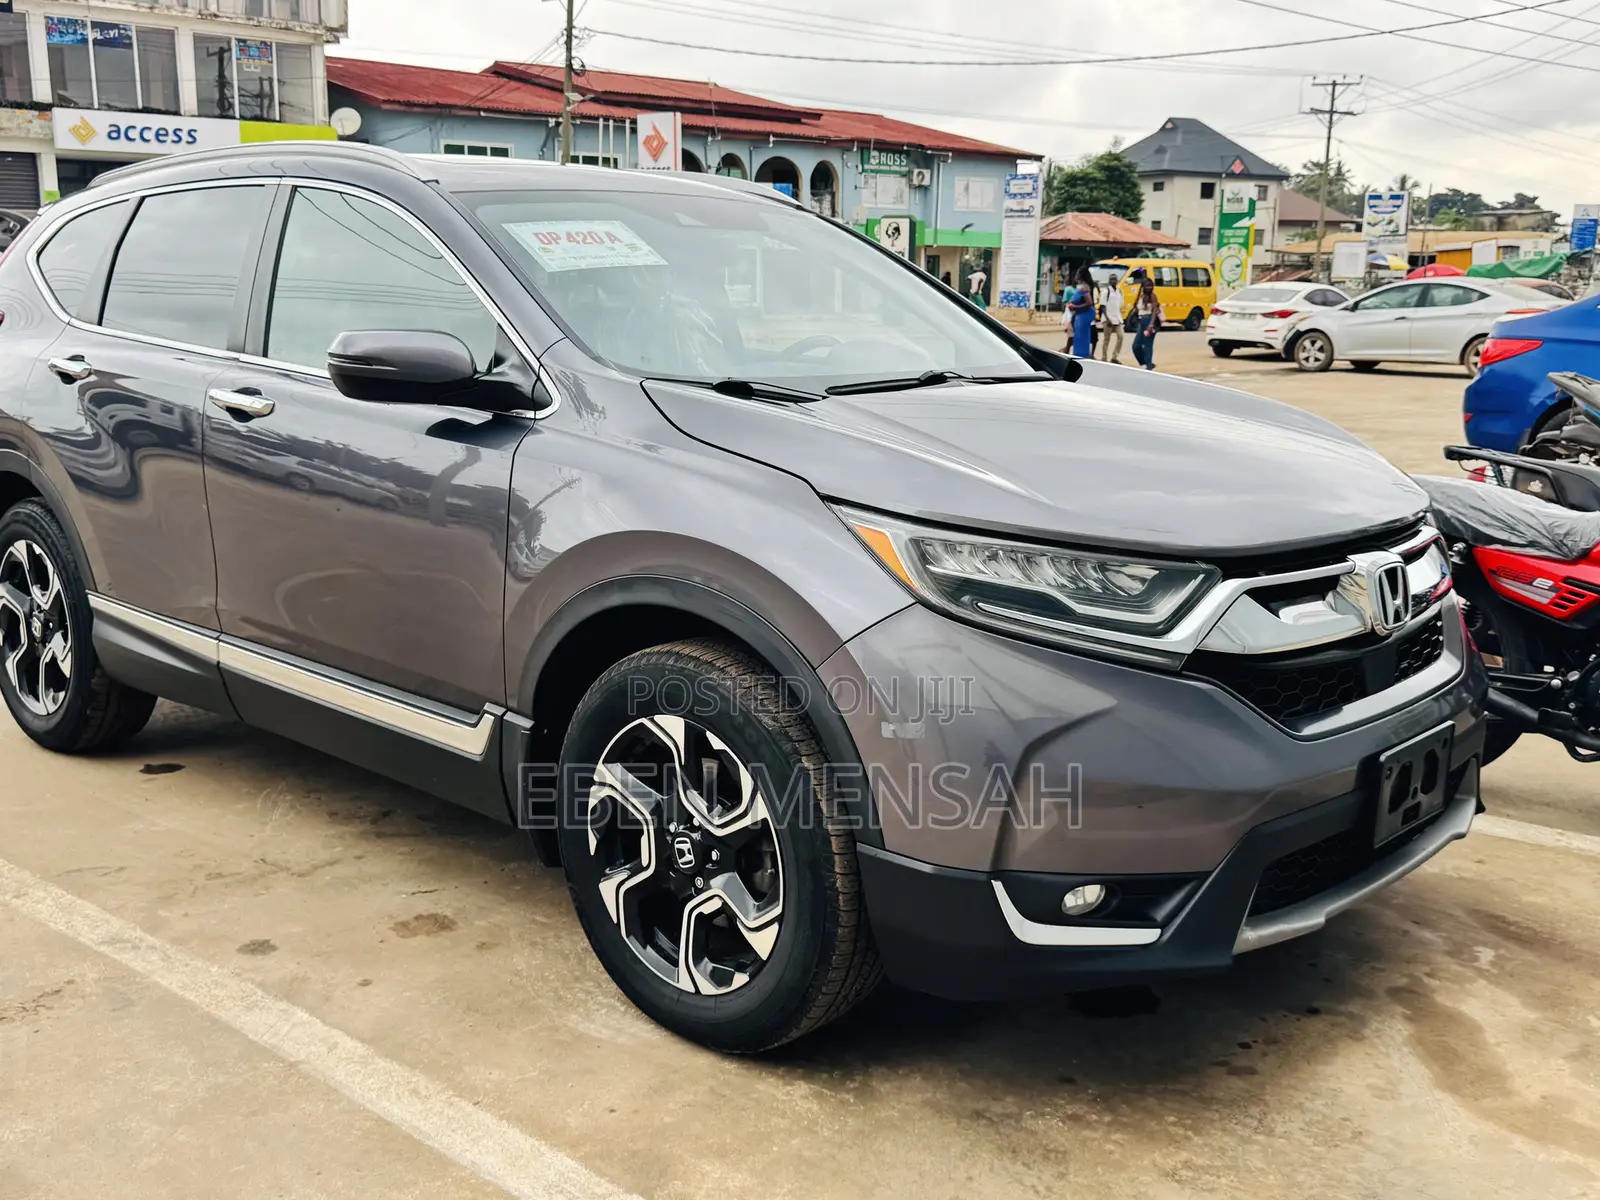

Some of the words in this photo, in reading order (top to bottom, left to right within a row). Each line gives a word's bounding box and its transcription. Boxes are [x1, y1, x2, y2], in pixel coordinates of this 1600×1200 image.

[107, 123, 198, 145] access
[565, 230, 606, 245] 420
[603, 231, 625, 245] A
